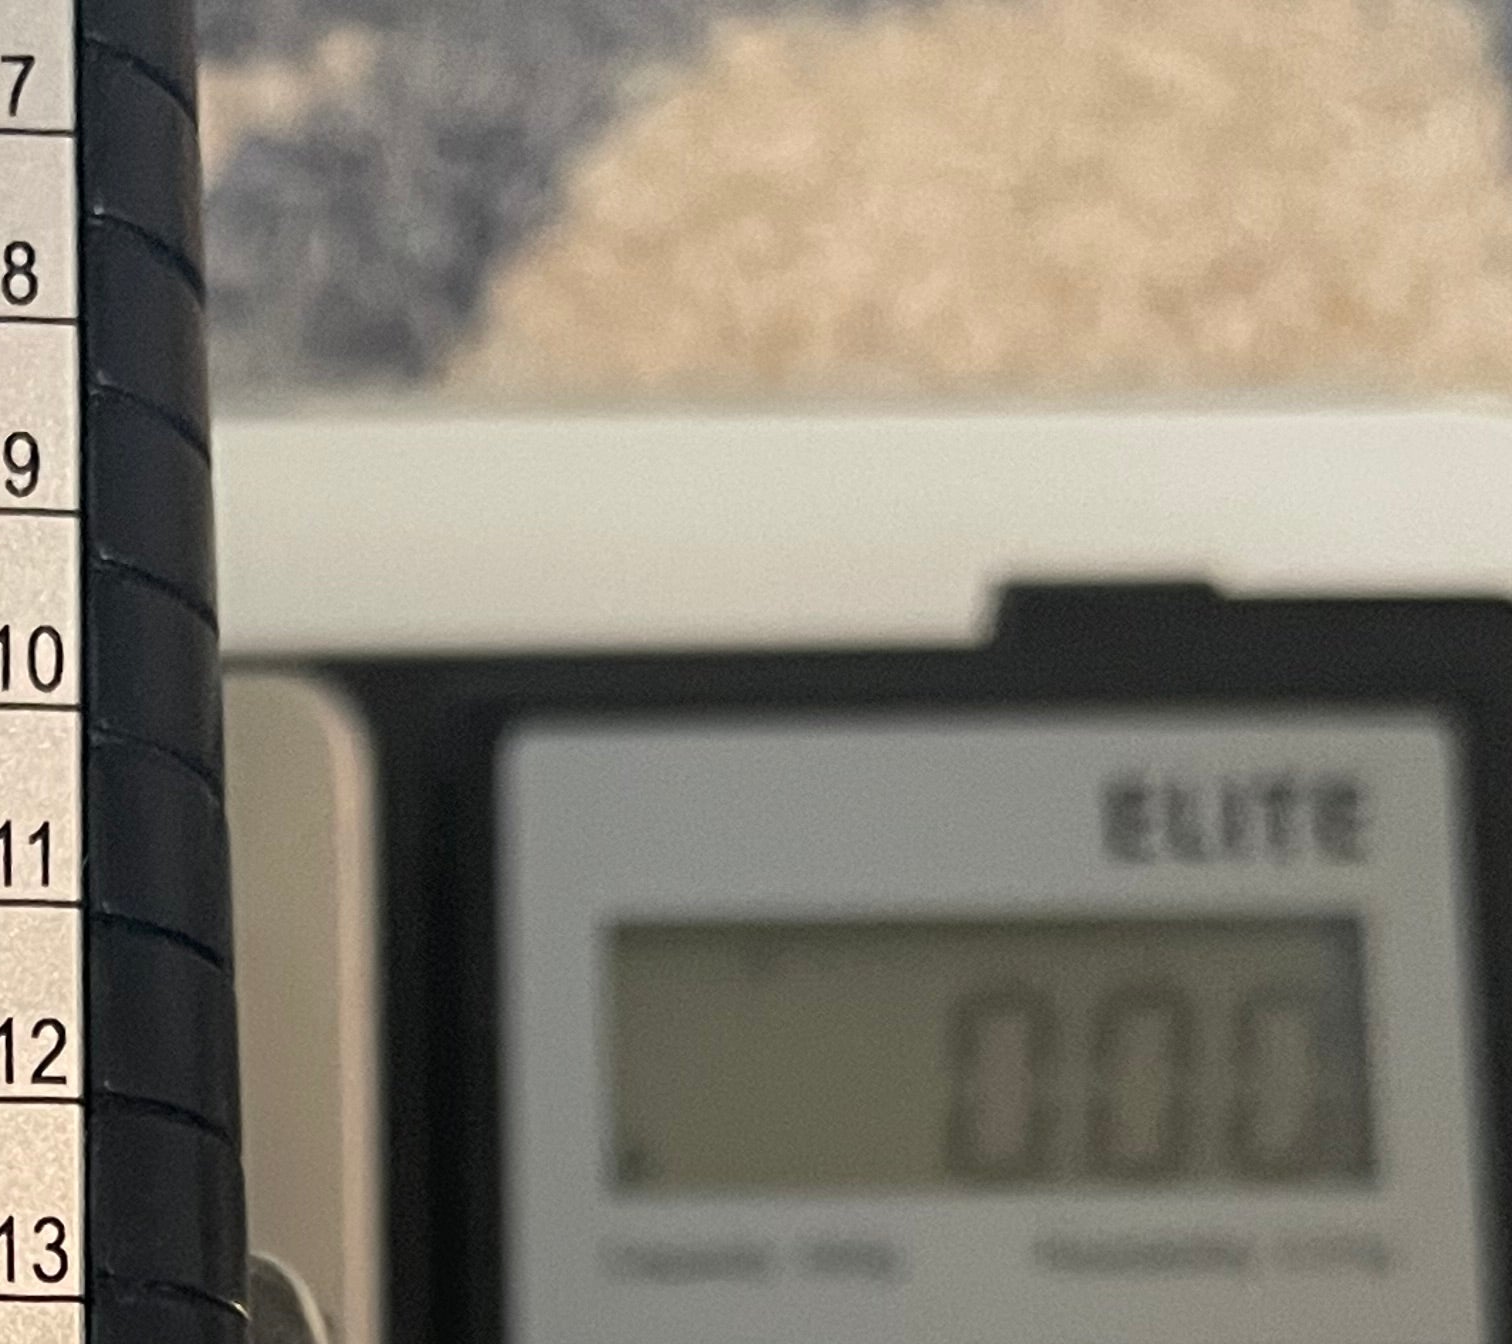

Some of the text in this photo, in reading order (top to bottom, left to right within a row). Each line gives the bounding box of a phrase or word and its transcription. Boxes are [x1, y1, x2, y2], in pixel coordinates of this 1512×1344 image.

[0, 54, 36, 118] 7
[0, 239, 39, 307] 8
[2, 431, 41, 499] 9
[1100, 768, 1370, 864] ELITE
